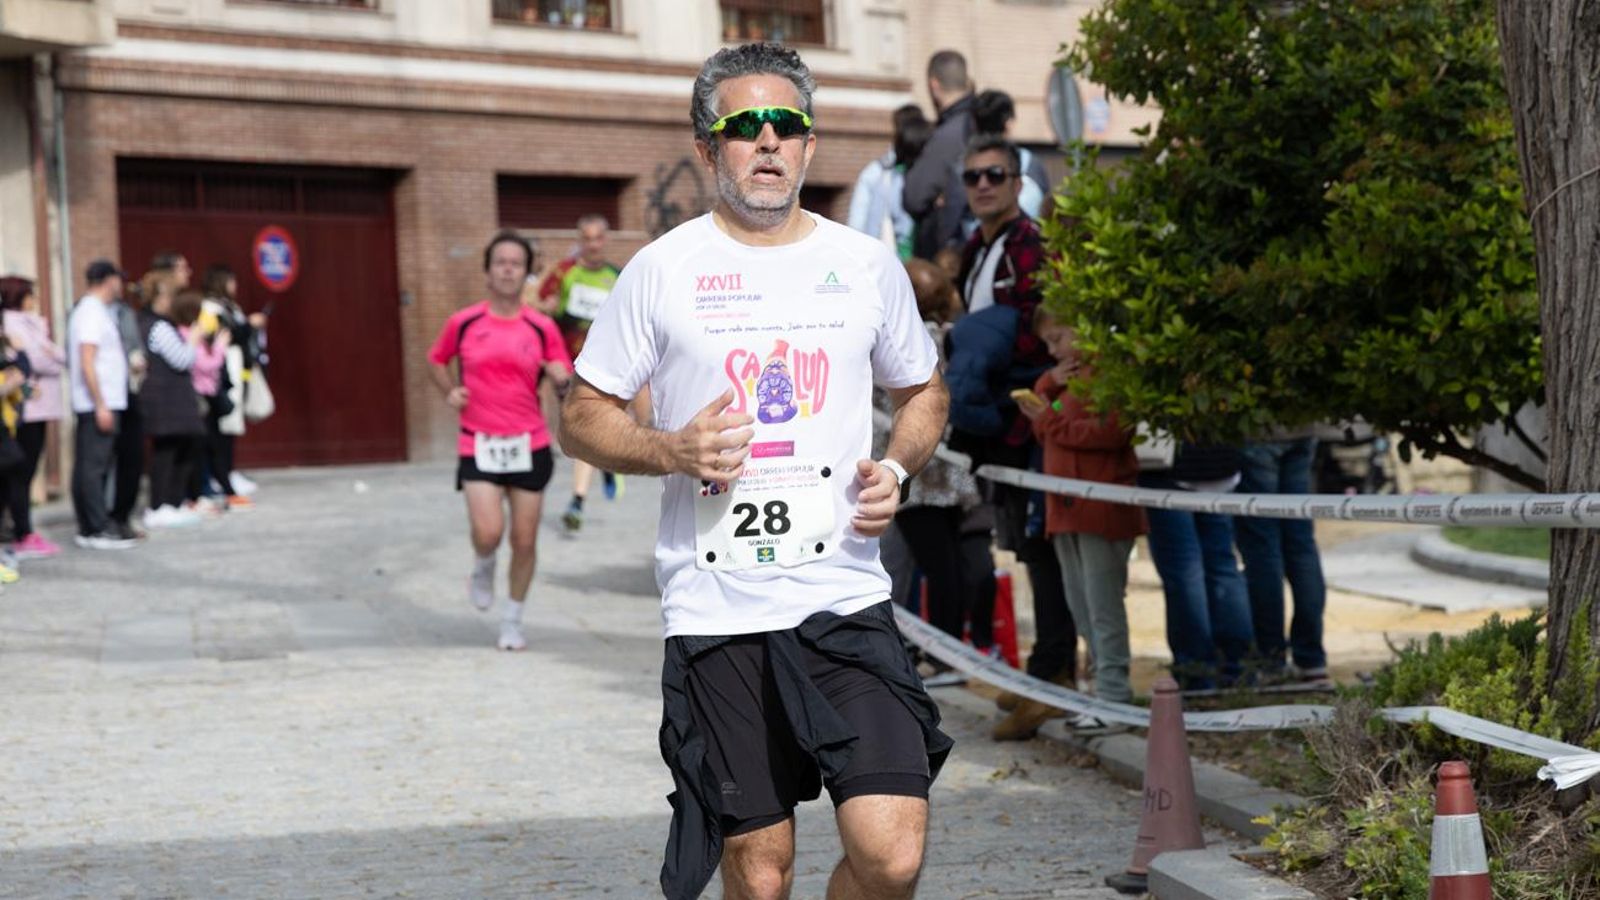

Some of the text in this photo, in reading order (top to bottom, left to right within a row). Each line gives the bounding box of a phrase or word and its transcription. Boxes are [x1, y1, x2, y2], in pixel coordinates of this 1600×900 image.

[695, 274, 743, 292] XXVII
[732, 500, 791, 538] 28
[748, 538, 781, 547] GONZALO
